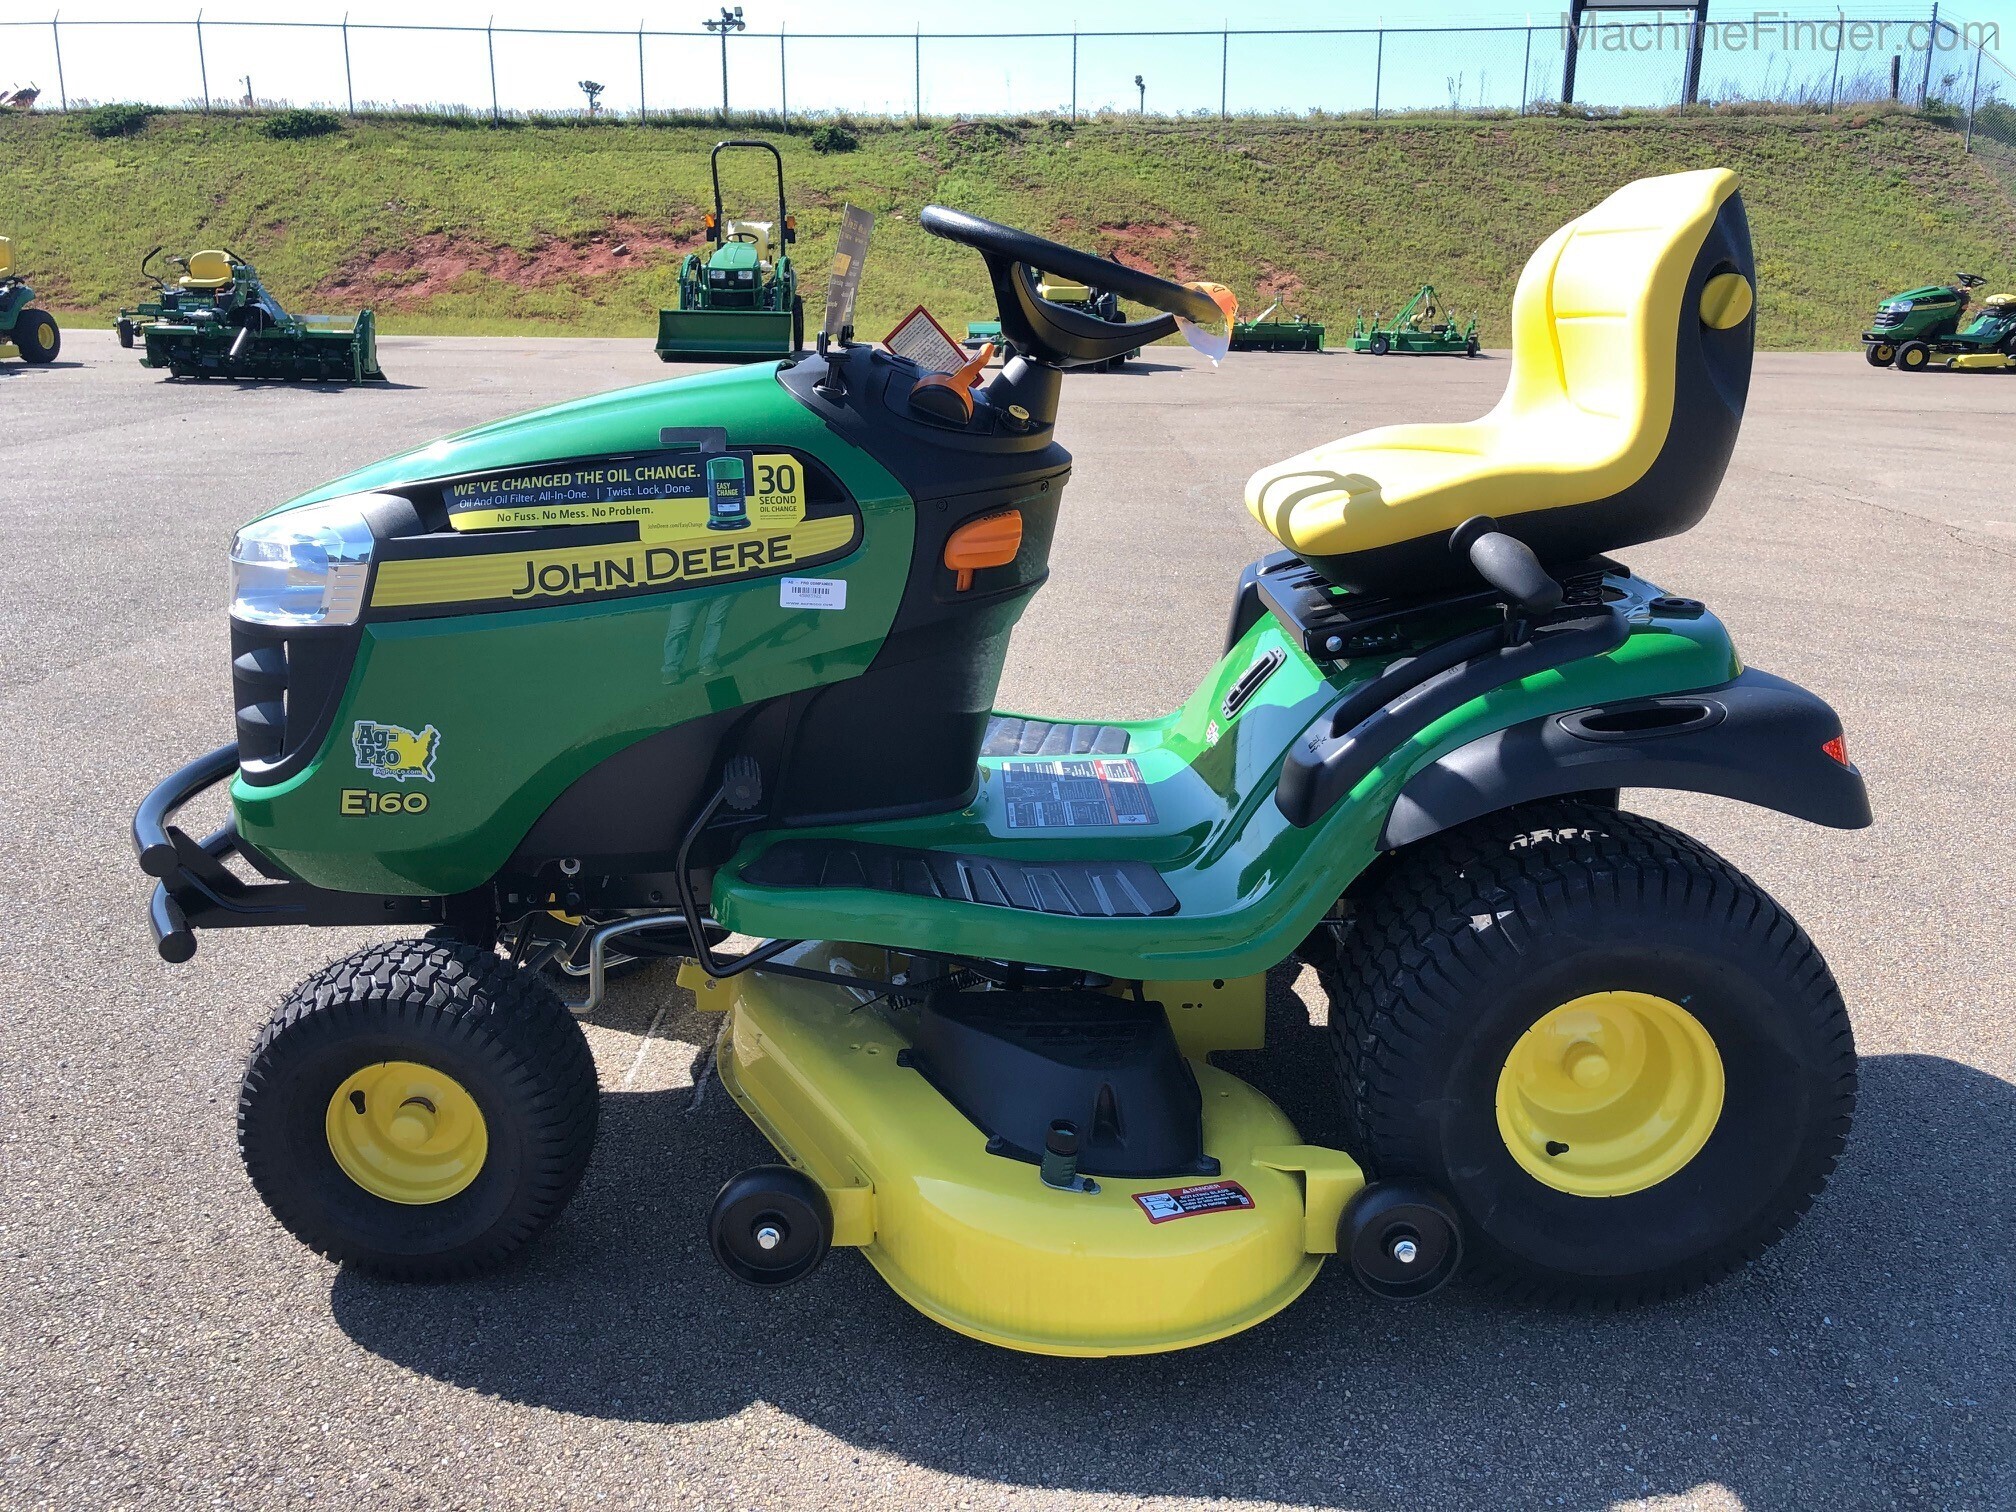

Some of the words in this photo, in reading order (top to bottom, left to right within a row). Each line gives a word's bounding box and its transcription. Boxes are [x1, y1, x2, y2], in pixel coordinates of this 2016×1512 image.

[454, 480, 498, 496] WE'VE
[502, 474, 571, 490] CHANGED
[575, 471, 603, 484] THE
[607, 469, 631, 483] OIL
[635, 464, 701, 480] CHANGE.
[716, 482, 731, 490] EASY
[758, 464, 796, 494] 30
[460, 499, 472, 508] Oil
[473, 497, 492, 507] And
[495, 495, 508, 505] Oil
[510, 493, 537, 503] Filter,
[539, 489, 589, 501] All-In-One.
[607, 486, 634, 497] Twist.
[637, 484, 662, 495] Lock.
[665, 483, 694, 494] Done.
[759, 495, 797, 505] SECOND
[497, 513, 511, 523] No
[514, 512, 539, 521] Fuss.
[542, 510, 557, 520] No
[559, 509, 589, 519] Mess.
[592, 507, 606, 517] No
[609, 505, 654, 516] Problem.
[512, 557, 635, 596] JOHN
[646, 534, 792, 582] DEERE
[359, 745, 401, 766] Pro
[341, 788, 428, 815] E160
[1190, 1184, 1221, 1193] DANGER
